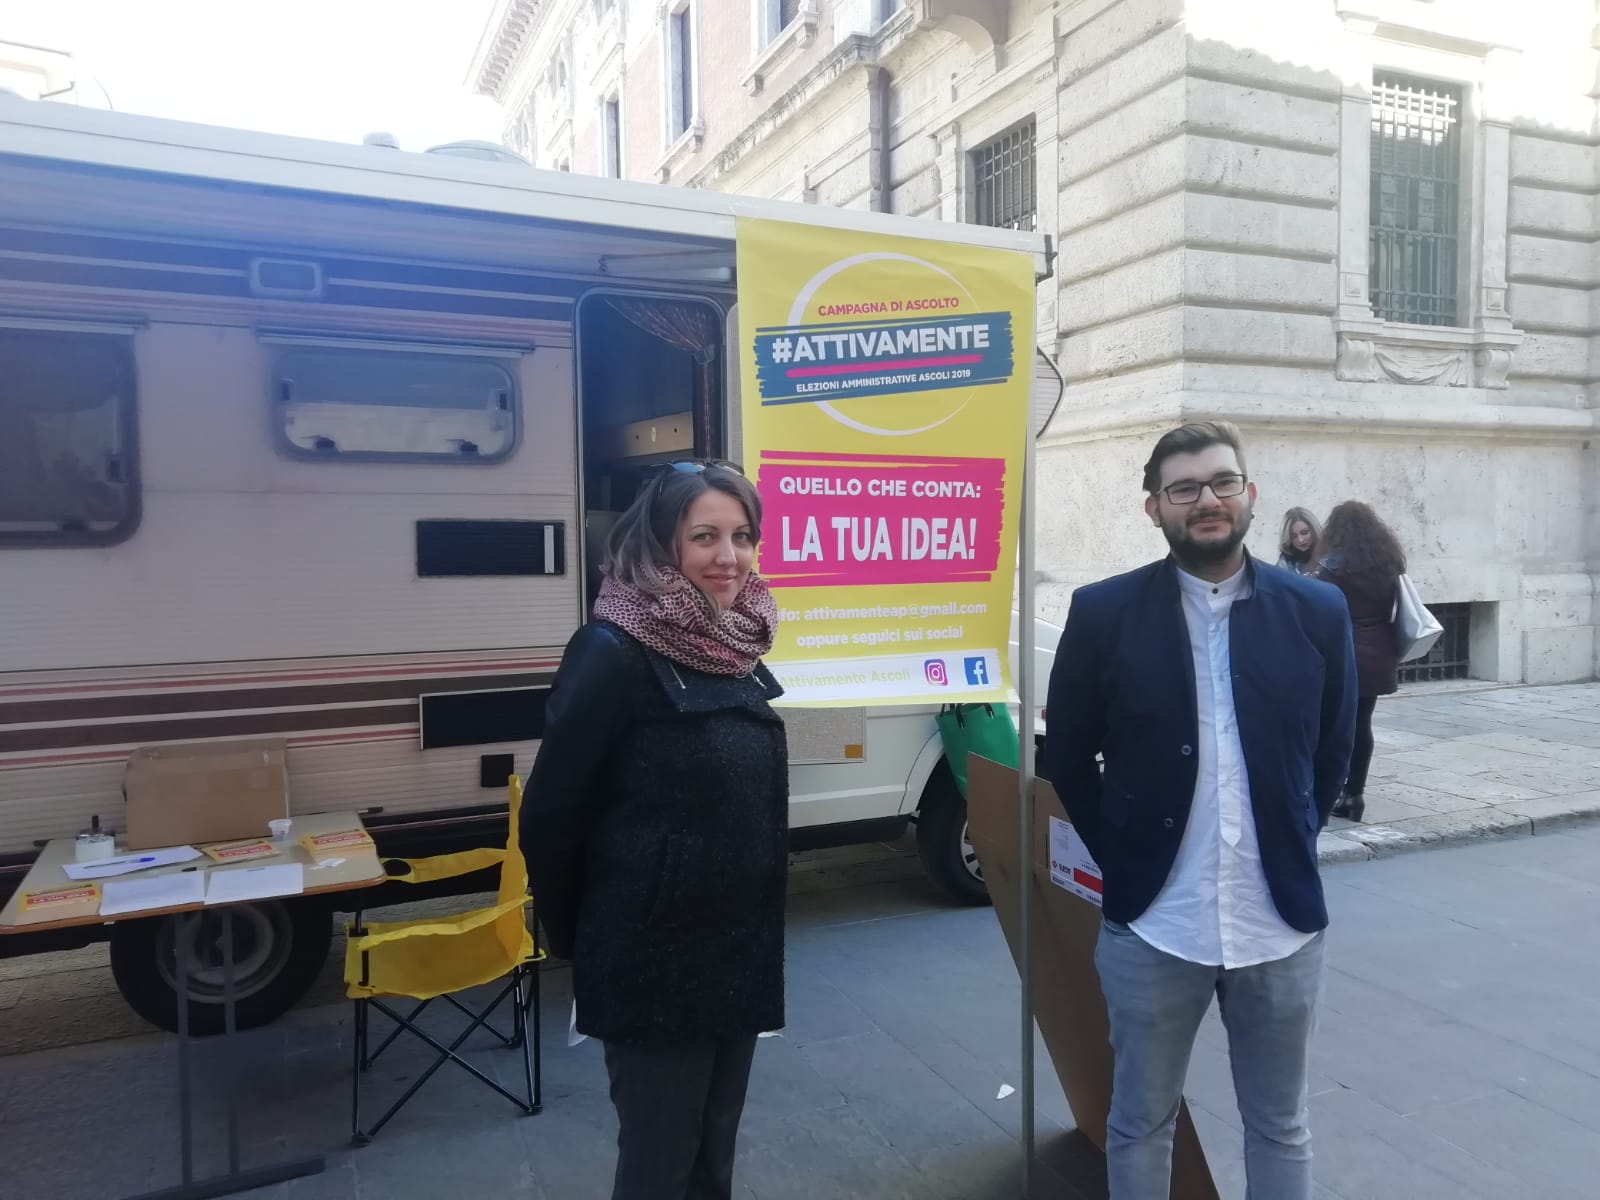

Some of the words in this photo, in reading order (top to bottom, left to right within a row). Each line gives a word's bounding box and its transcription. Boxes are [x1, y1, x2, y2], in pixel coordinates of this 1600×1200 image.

[818, 302, 888, 317] CAMPAGNA
[890, 300, 903, 312] DI
[906, 297, 960, 312] ASCOLTO
[772, 324, 990, 363] #ATTIVAMENTE
[796, 382, 840, 393] ELEZIONI
[841, 374, 917, 389] AMMINISTRATIVE
[918, 371, 951, 382] ASCOLI
[951, 369, 971, 379] 2019
[779, 476, 862, 496] QUELLO
[867, 479, 907, 497] CHE
[911, 480, 982, 498] CONTA:
[782, 516, 824, 562] LA
[831, 516, 893, 562] TUA
[901, 517, 977, 561] IDEA!
[776, 607, 801, 622] fo:
[804, 601, 987, 621] attivamenteap@gmail.com
[796, 633, 849, 648] oppure
[852, 628, 900, 645] seguici
[903, 627, 923, 642] sui
[926, 625, 963, 640] social
[870, 667, 911, 682] Ascoli
